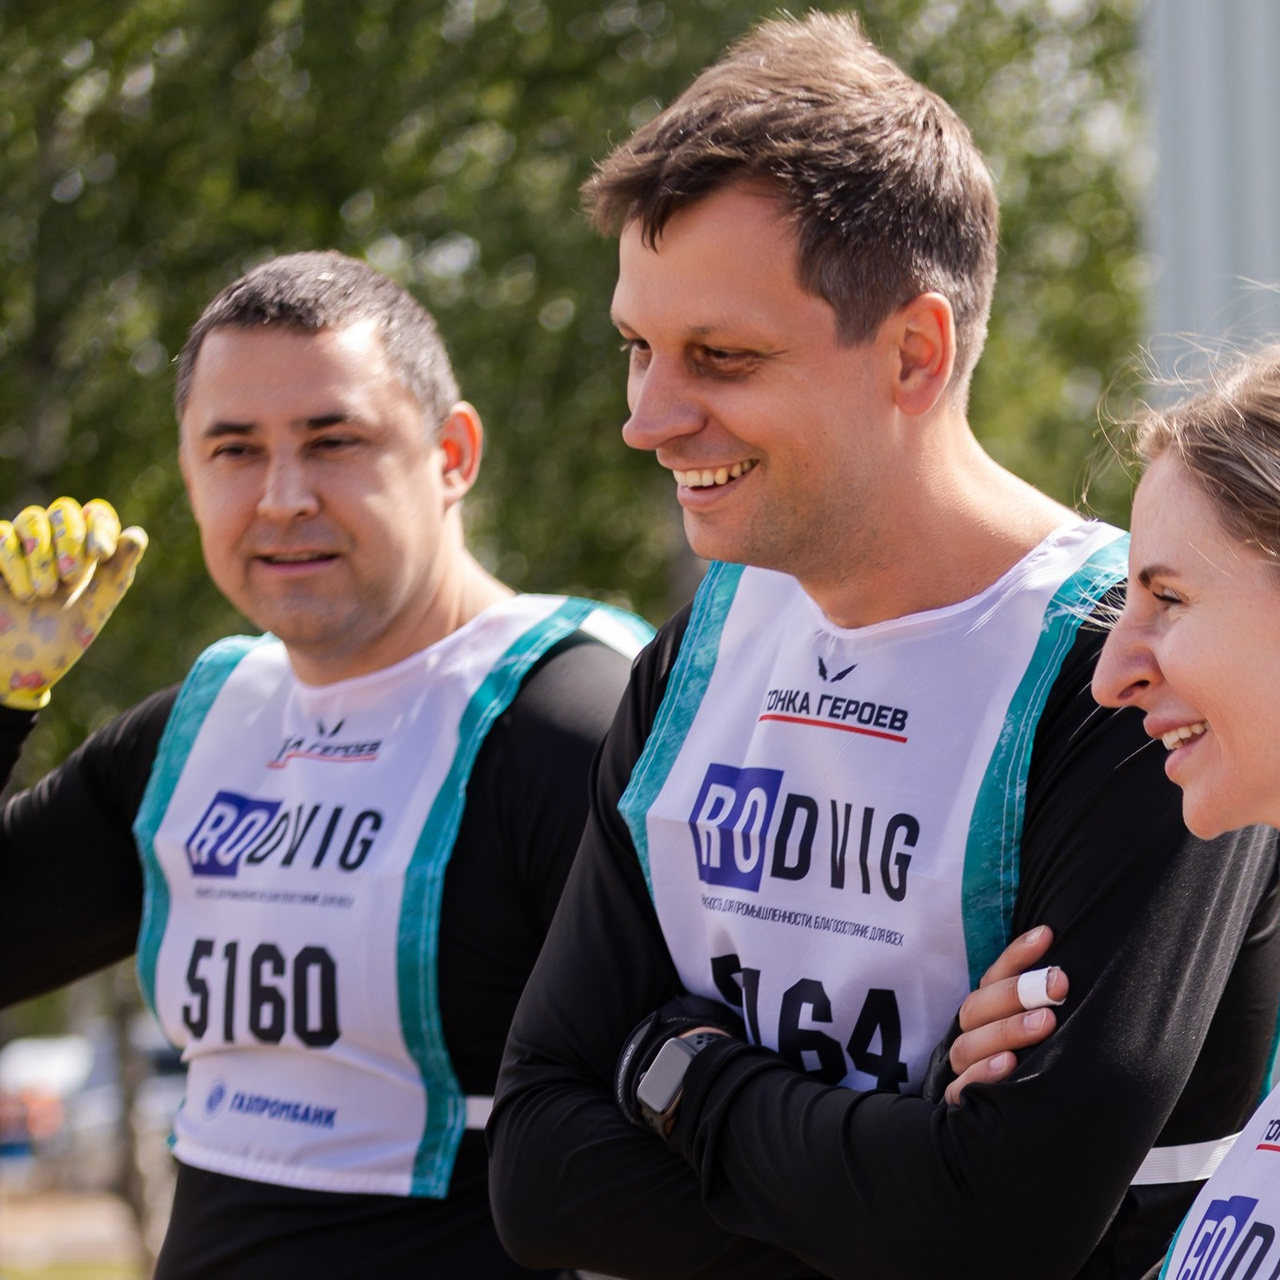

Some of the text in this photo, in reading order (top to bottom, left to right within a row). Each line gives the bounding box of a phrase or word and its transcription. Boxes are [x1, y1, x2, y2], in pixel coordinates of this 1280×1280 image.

[816, 694, 908, 732] ГЕРОЕВ
[189, 801, 383, 872] RODVIG
[696, 783, 920, 902] RODVIG
[183, 939, 340, 1048] 5160
[228, 1091, 339, 1129] ГАЗПРОМБАНК
